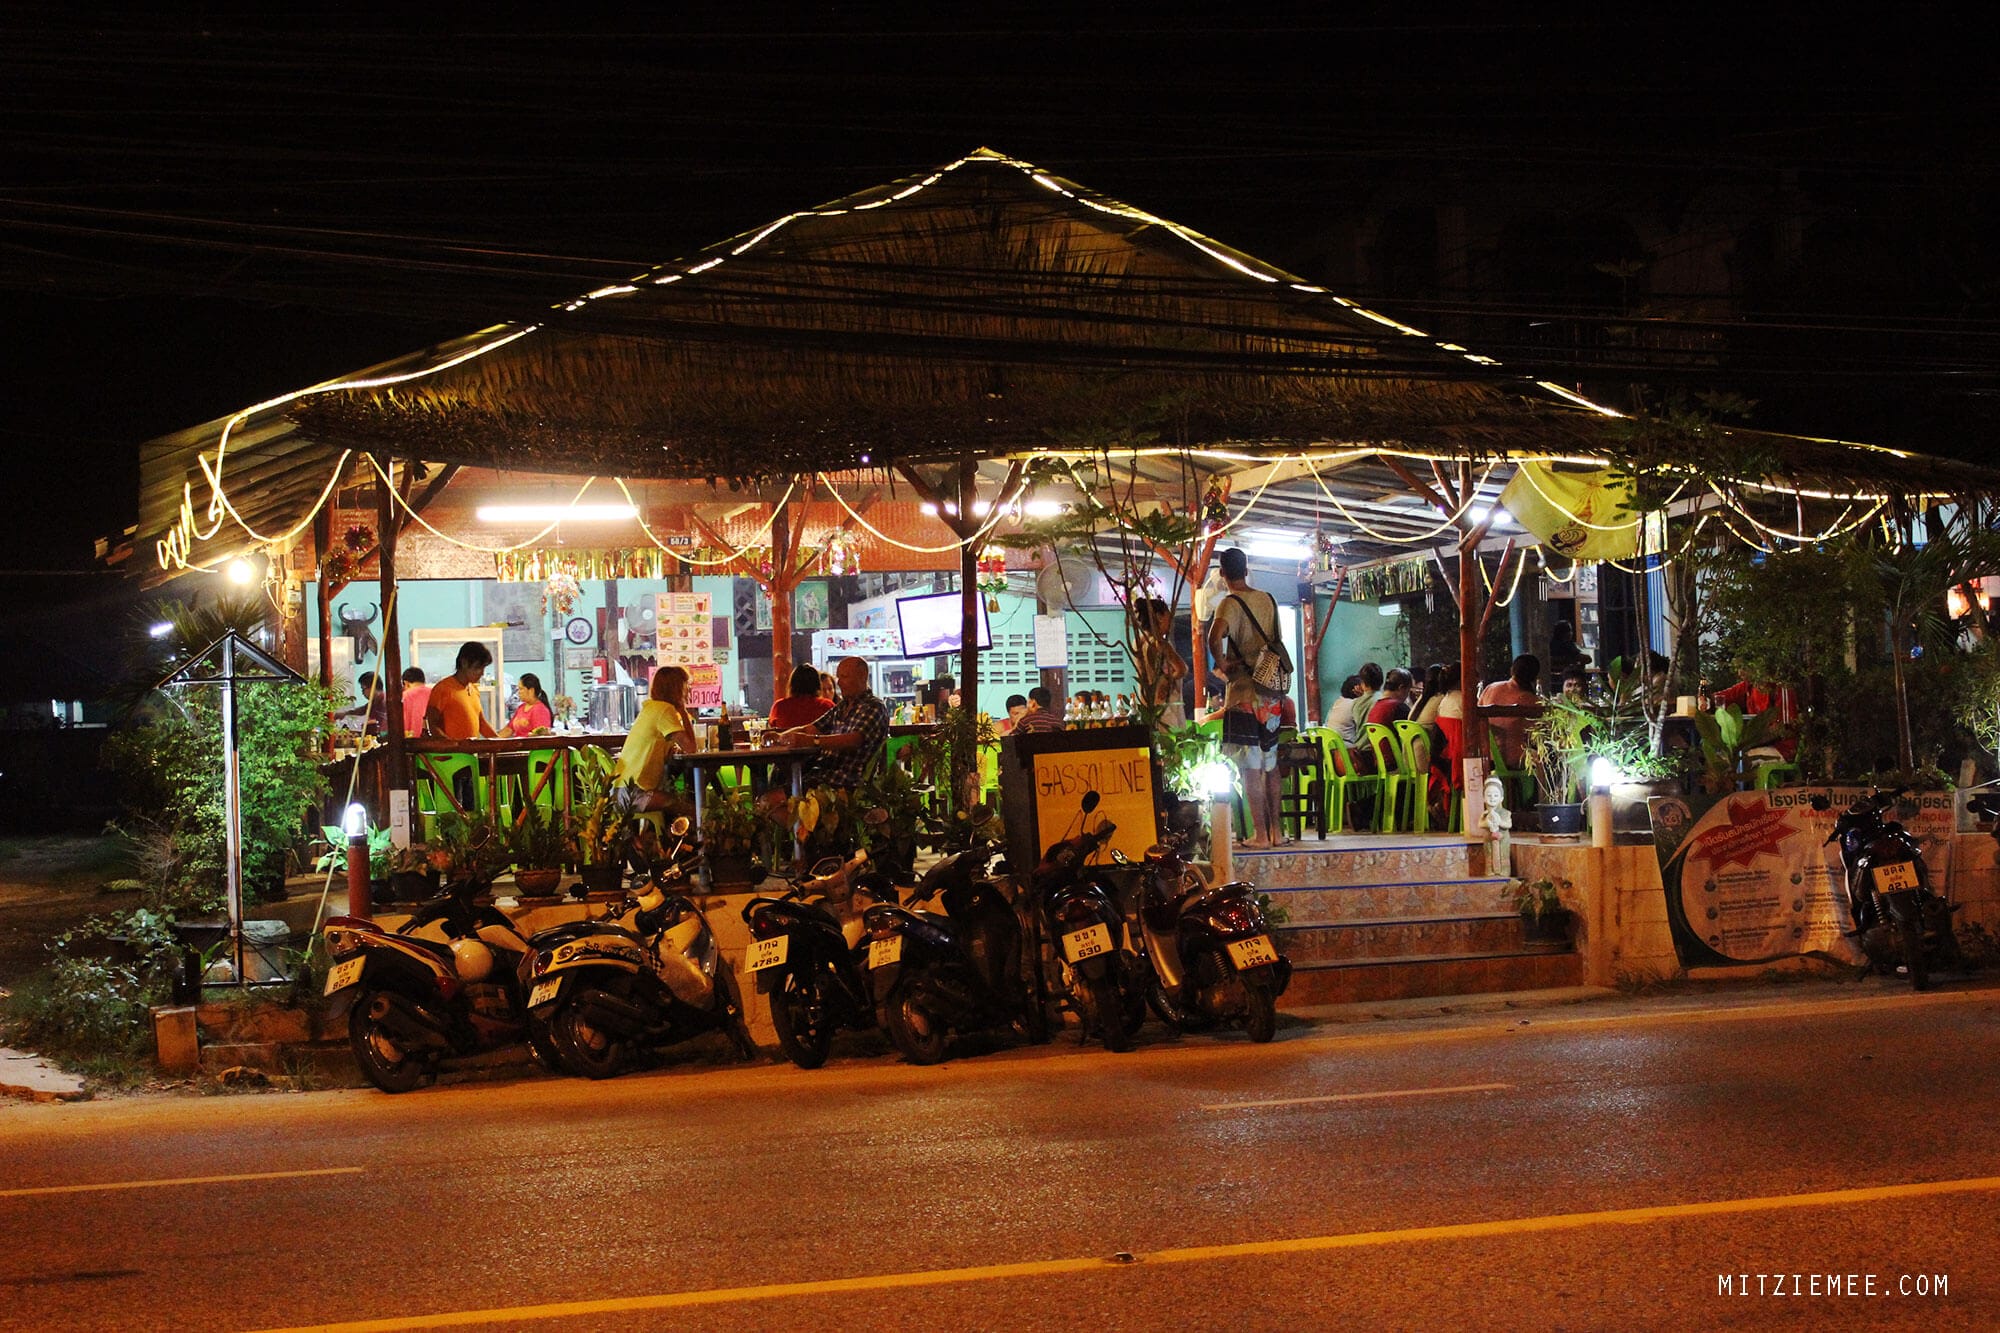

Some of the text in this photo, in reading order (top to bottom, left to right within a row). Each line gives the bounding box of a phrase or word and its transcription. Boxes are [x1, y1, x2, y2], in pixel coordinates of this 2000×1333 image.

[1036, 759, 1145, 797] GASSOLINE
[1887, 881, 1909, 891] 421
[1078, 944, 1102, 958] 630
[752, 956, 780, 968] 4789
[1243, 954, 1271, 968] 1254
